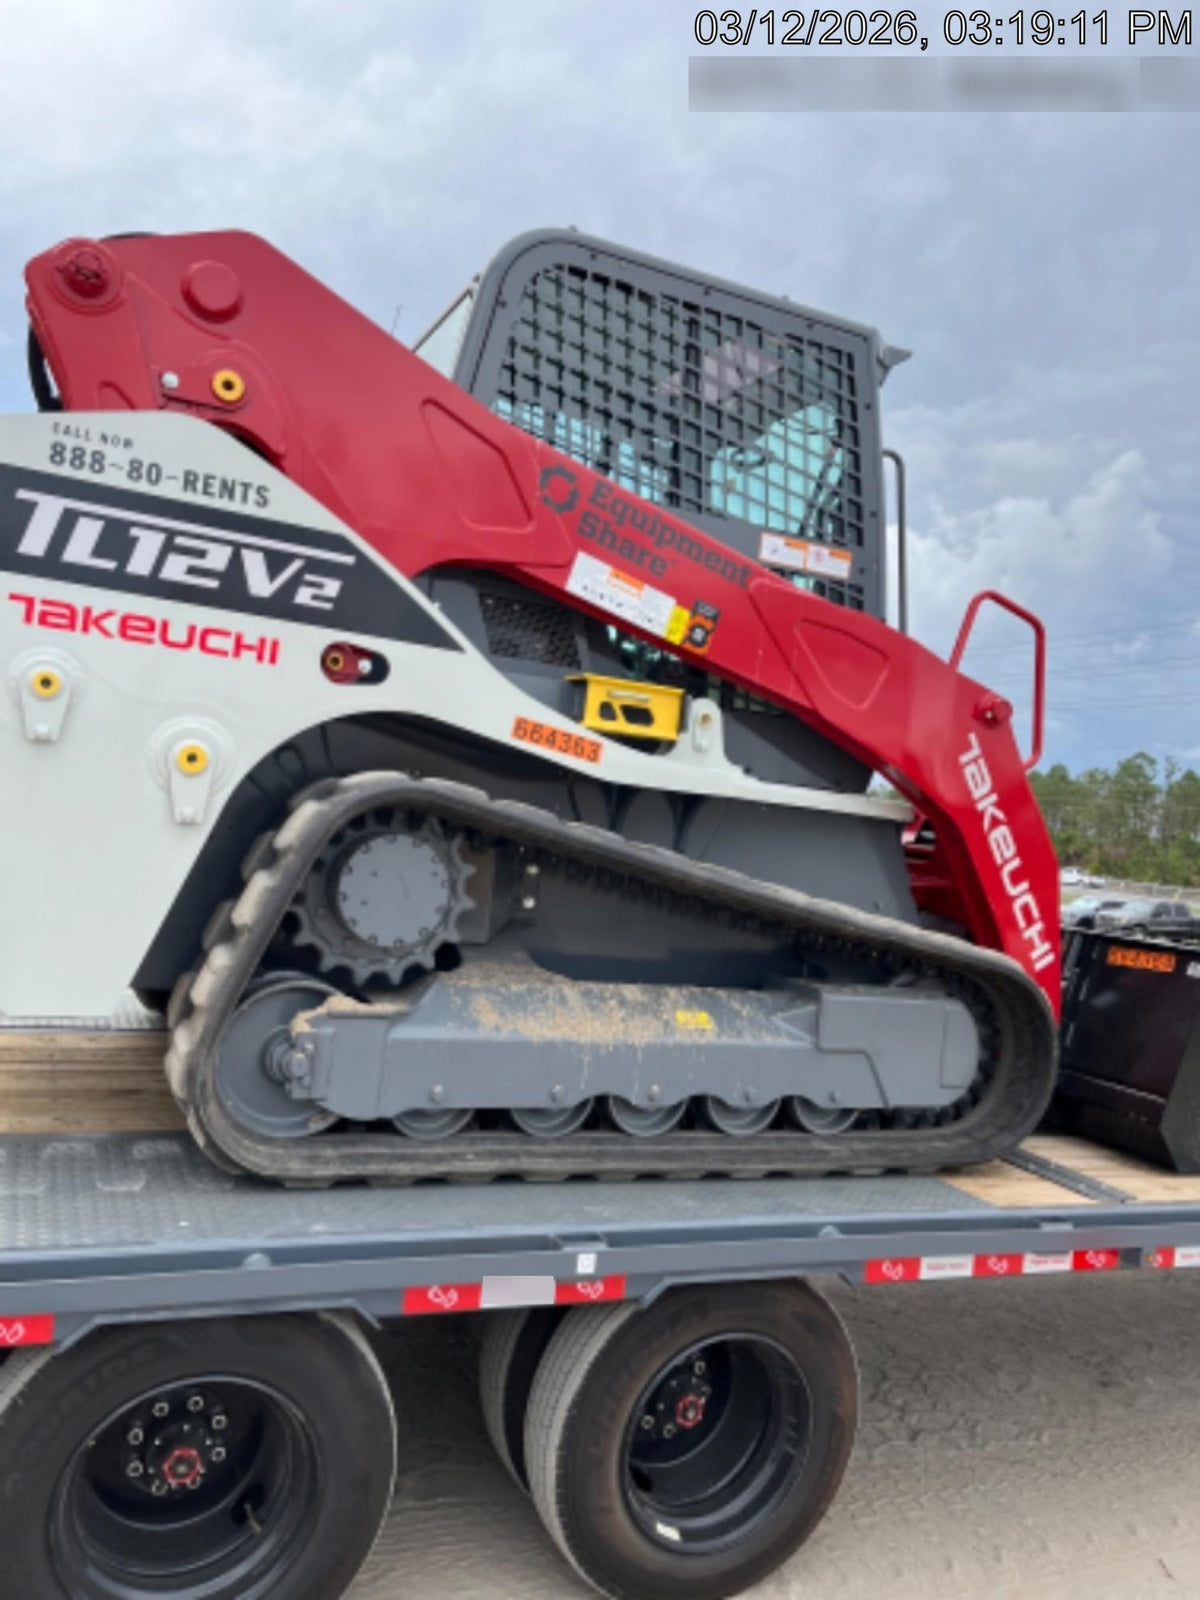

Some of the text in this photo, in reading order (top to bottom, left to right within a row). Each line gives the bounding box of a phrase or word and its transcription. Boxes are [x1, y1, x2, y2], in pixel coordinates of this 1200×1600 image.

[52, 421, 134, 449] CALL NOW
[50, 441, 271, 508] 888-80-RENTS
[14, 488, 356, 610] TL12V2
[576, 512, 669, 577] Share
[589, 483, 752, 587] Equipment
